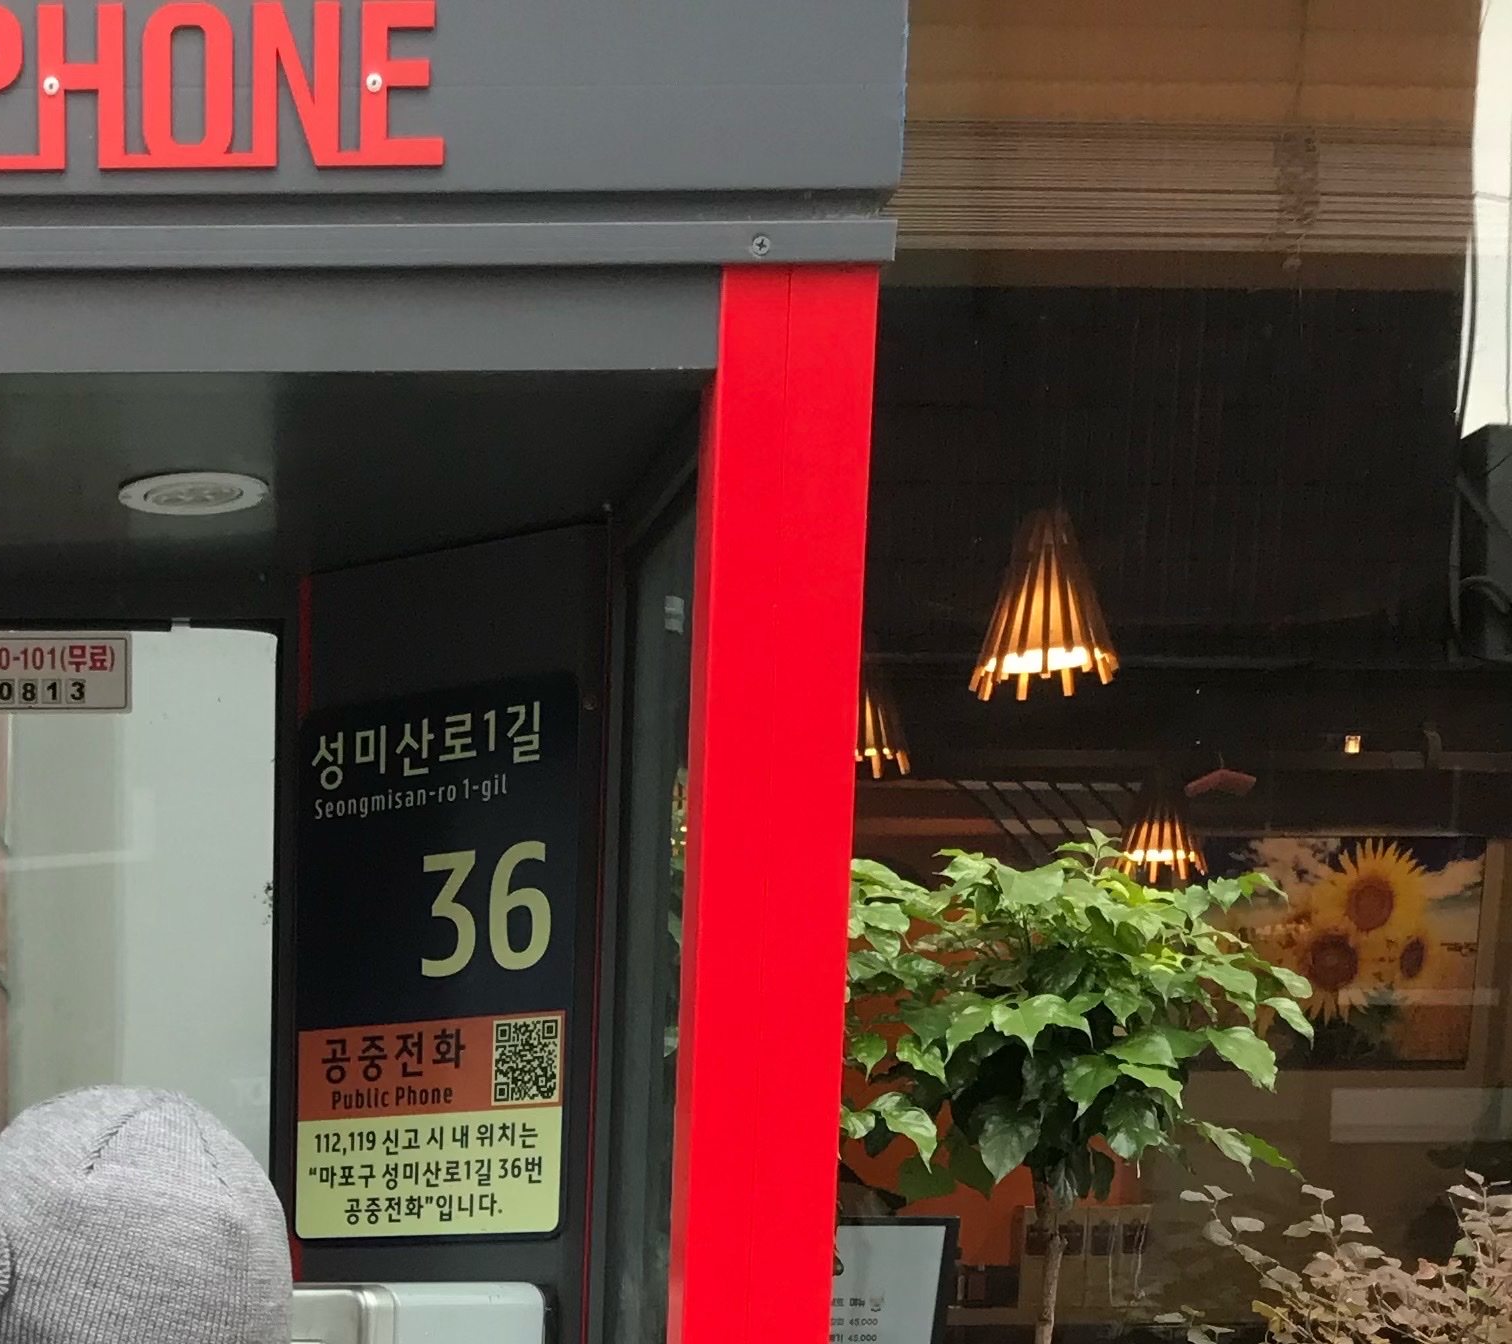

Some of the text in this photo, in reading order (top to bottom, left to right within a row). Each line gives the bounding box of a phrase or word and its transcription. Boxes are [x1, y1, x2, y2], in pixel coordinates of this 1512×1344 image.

[311, 701, 541, 790] 성미산로1길
[314, 773, 507, 820] Seongmisan-ro 1-gil
[421, 840, 551, 978] 36
[321, 1028, 466, 1084] 공중전화
[331, 1086, 453, 1110] Public Phone
[314, 1122, 538, 1155] 112,119 신고 시 내 위치는
[382, 1158, 492, 1190] 성미산로1길
[498, 1156, 543, 1184] 36번
